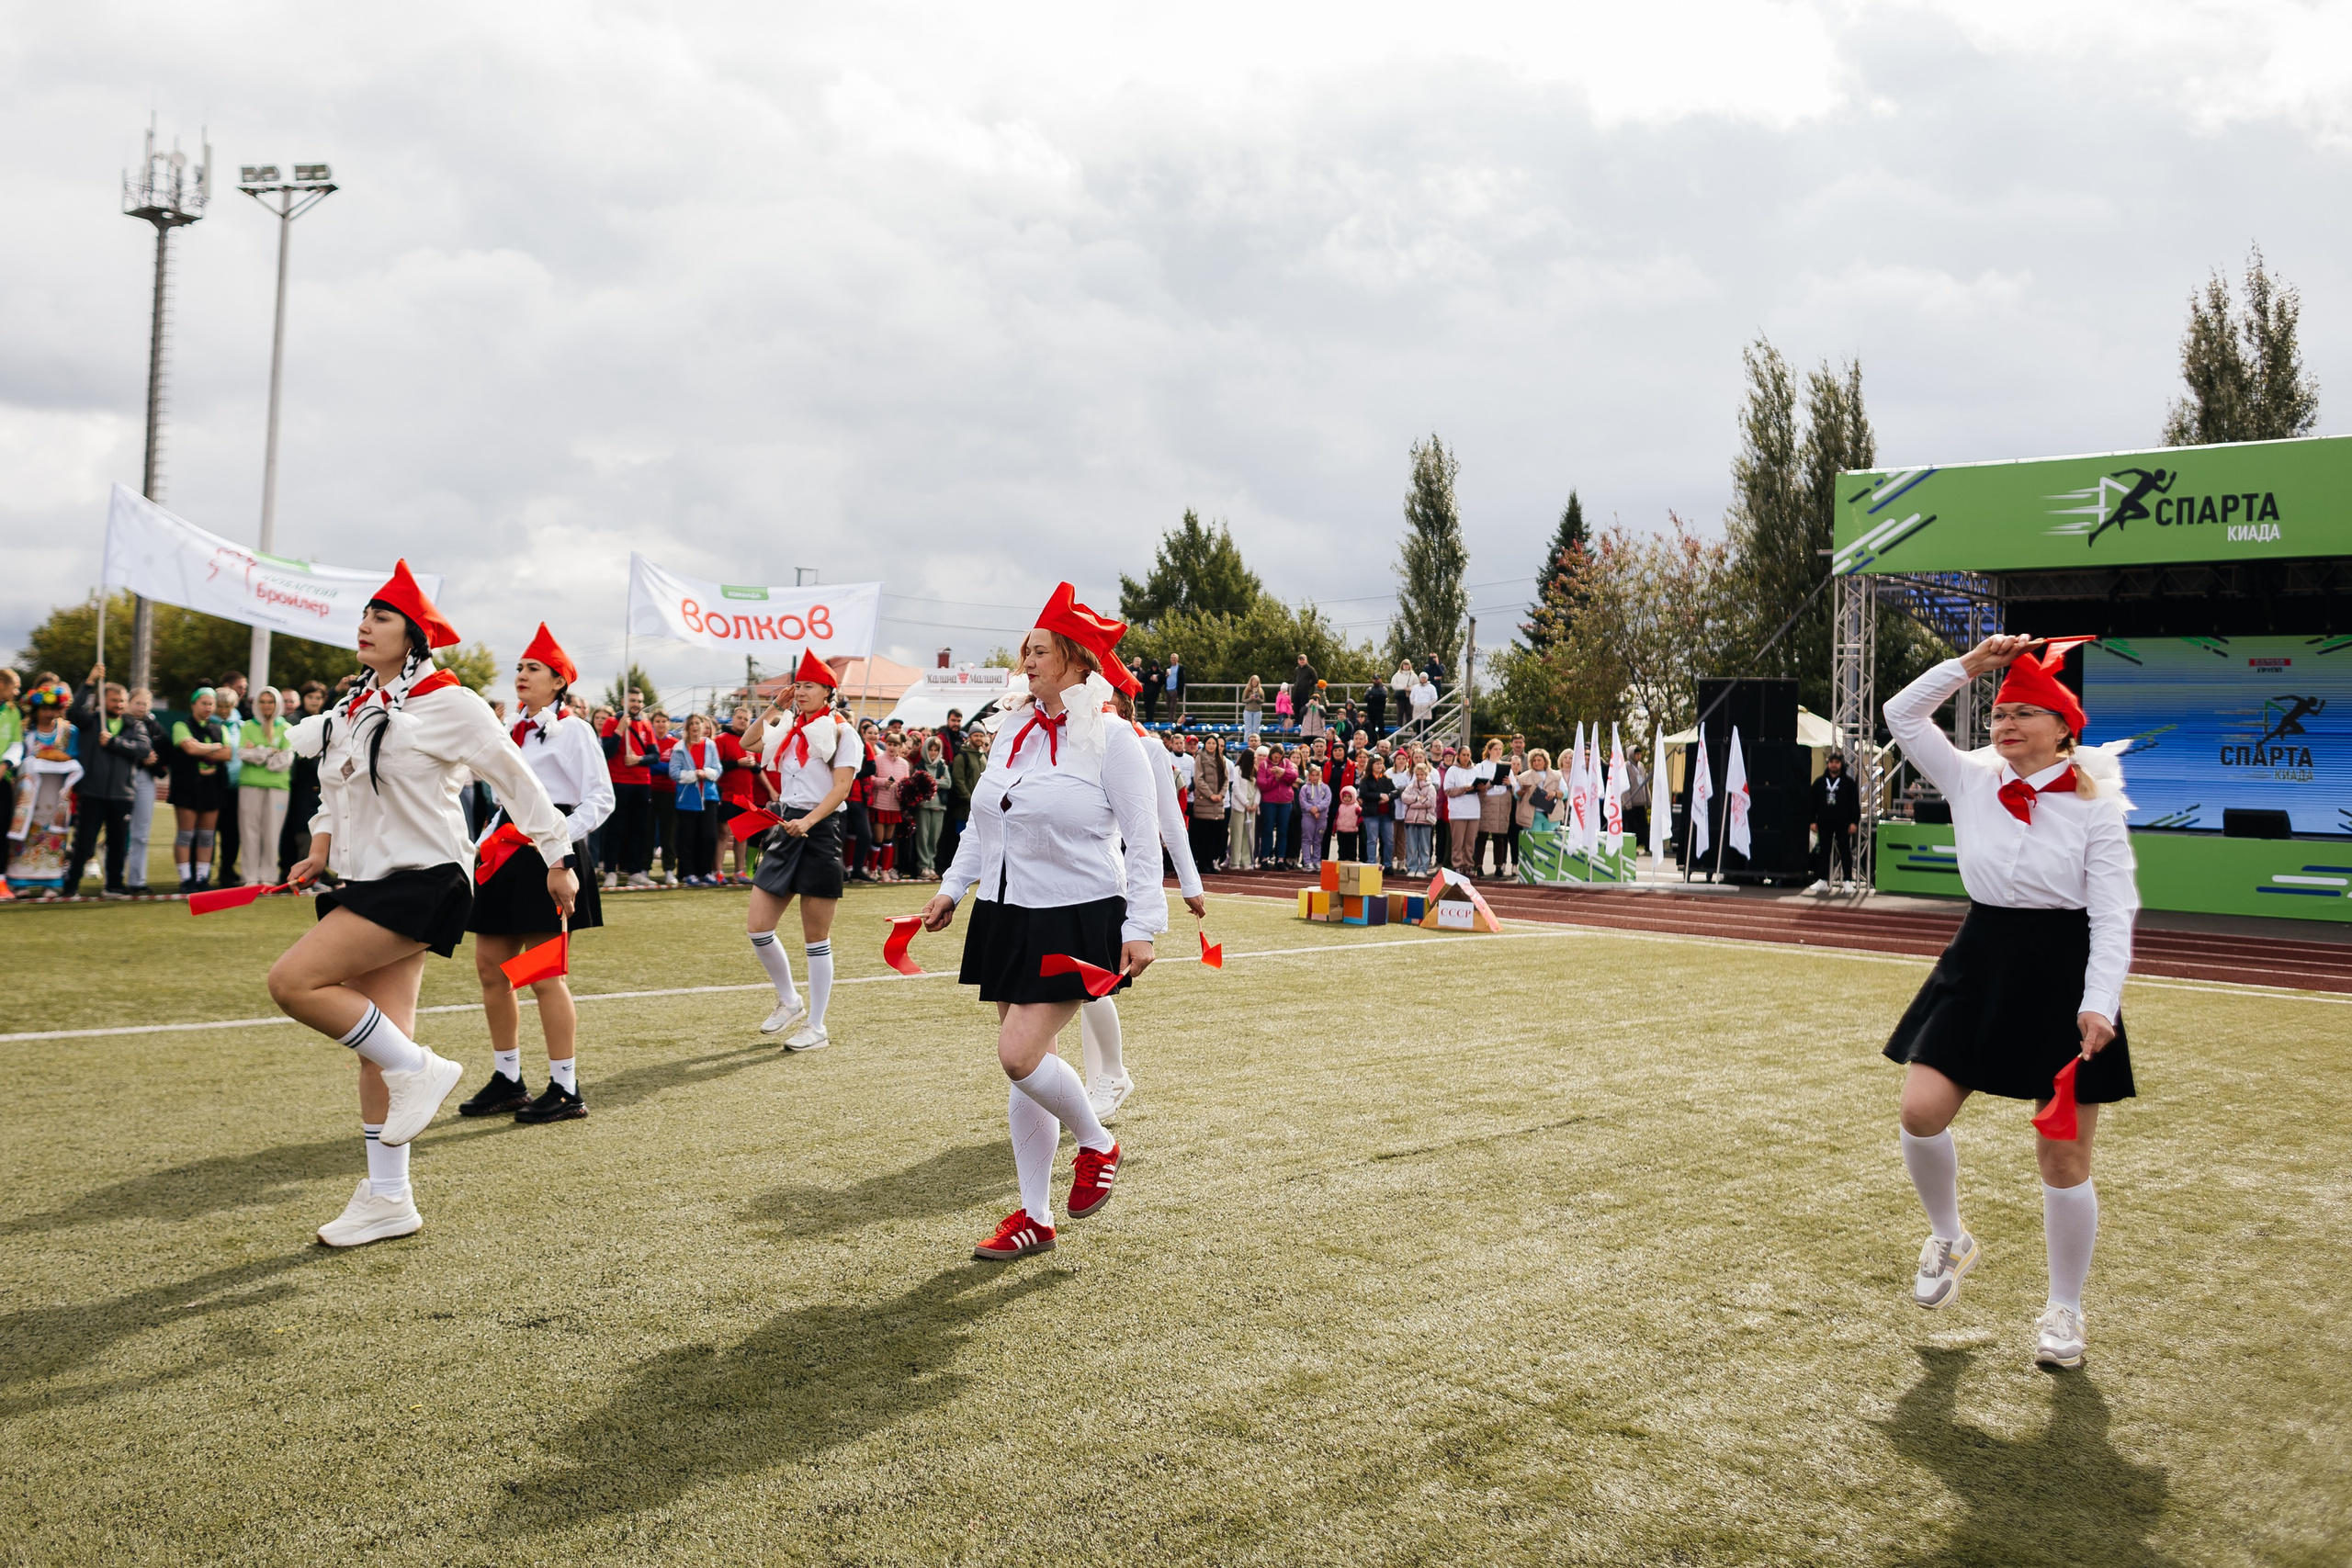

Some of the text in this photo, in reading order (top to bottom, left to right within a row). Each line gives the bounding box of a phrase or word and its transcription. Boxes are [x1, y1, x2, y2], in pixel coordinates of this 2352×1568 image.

[2154, 491, 2280, 527] СПАРТА
[2227, 524, 2280, 543] КИАДА
[256, 581, 330, 617] Бройлер
[926, 673, 1003, 684] Калина Малина
[2220, 744, 2313, 768] СПАРТА
[2274, 769, 2313, 783] КИАДА
[1440, 908, 1472, 919] СССР
